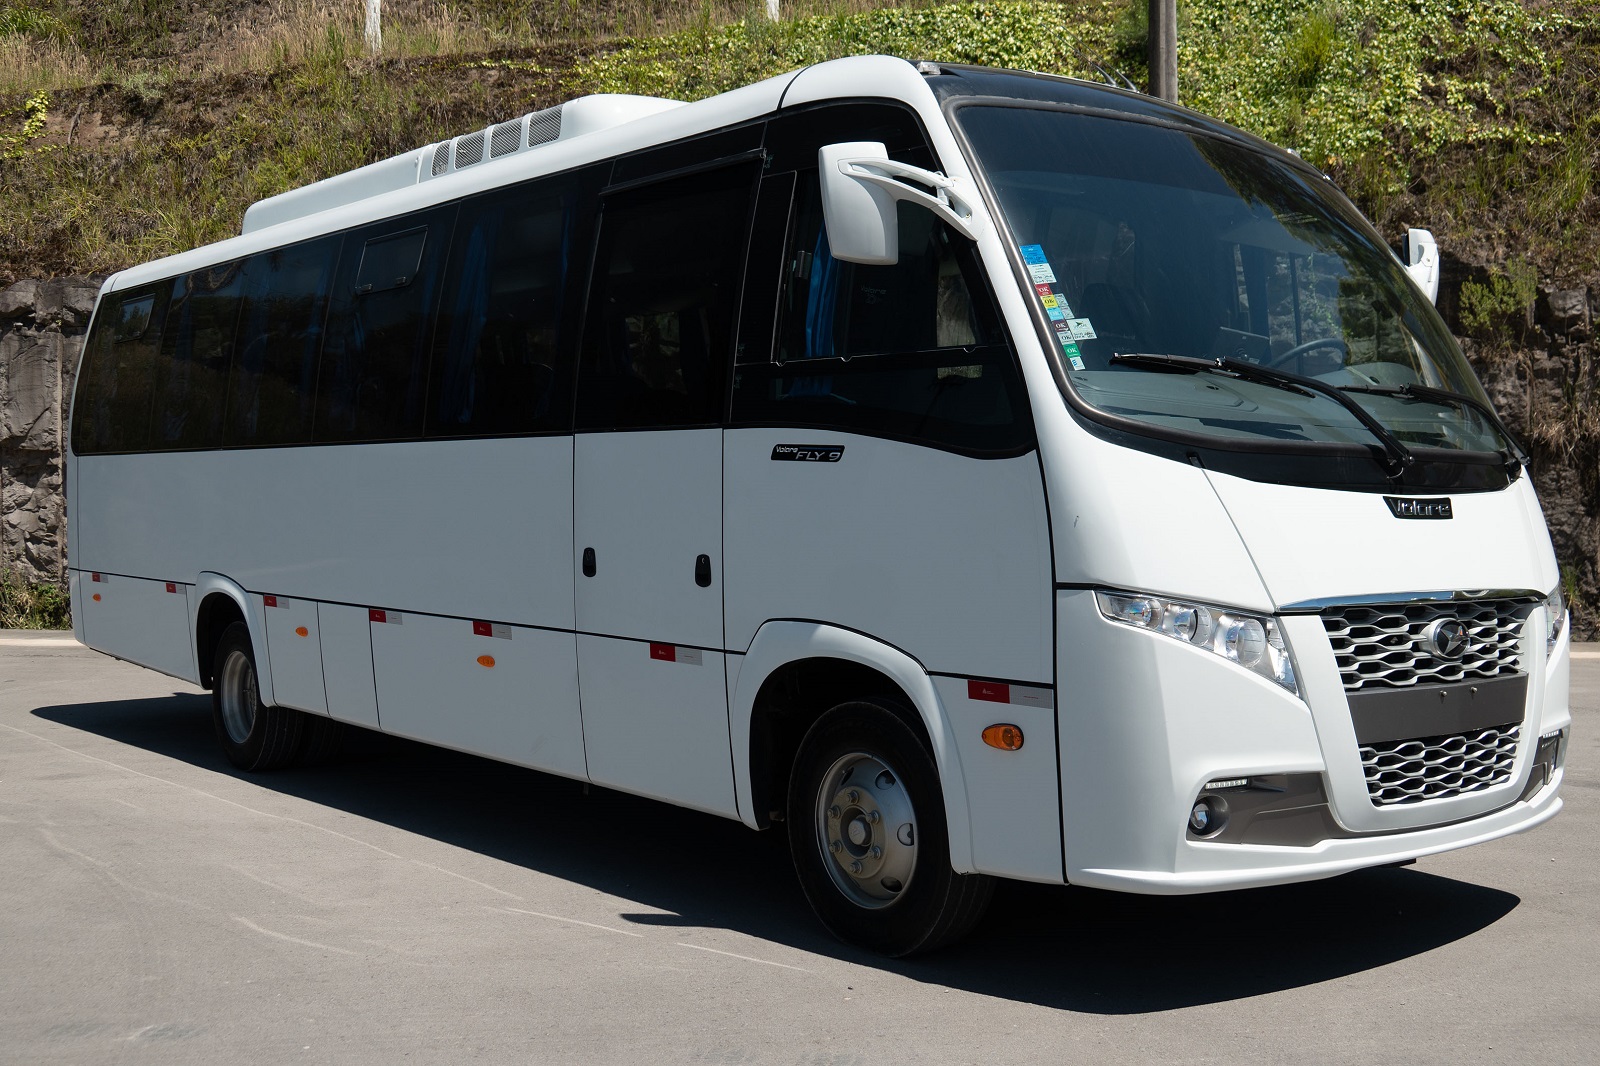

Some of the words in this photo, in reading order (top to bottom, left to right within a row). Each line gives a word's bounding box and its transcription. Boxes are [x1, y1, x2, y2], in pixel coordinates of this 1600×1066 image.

[775, 445, 799, 453] Volare
[795, 451, 826, 461] FLY
[828, 451, 841, 461] 9
[1389, 499, 1451, 516] Volare
